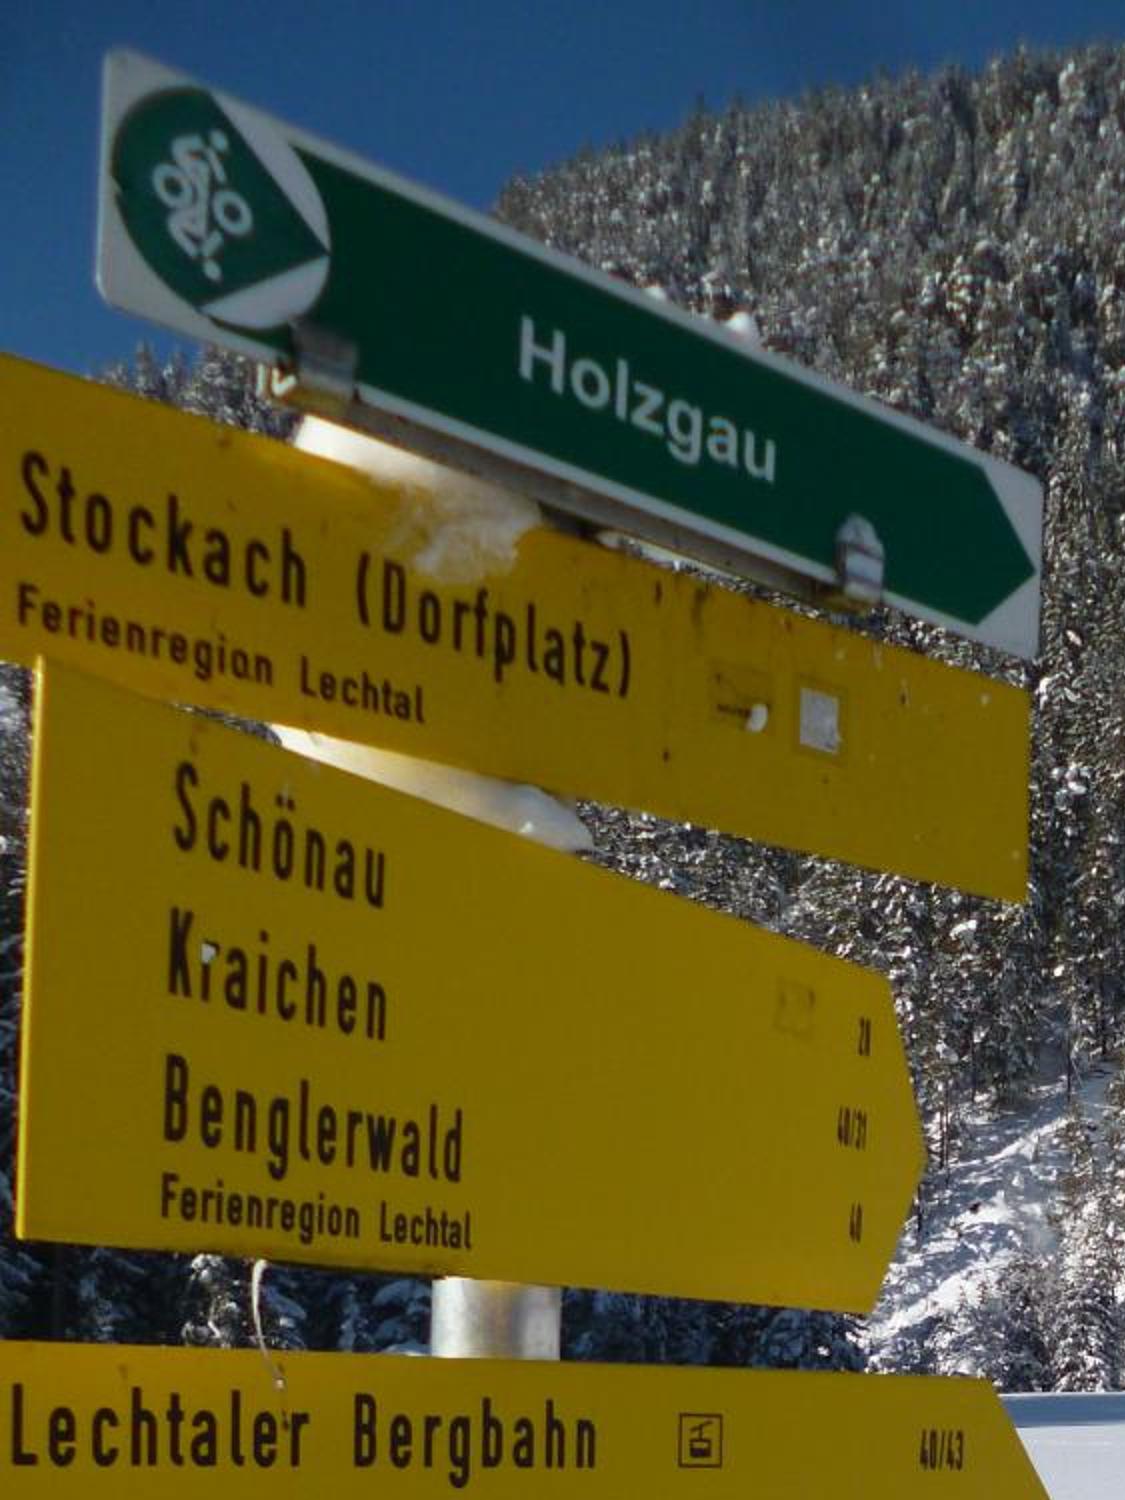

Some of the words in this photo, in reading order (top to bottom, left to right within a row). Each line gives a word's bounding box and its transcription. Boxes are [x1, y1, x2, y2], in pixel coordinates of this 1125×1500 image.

[518, 314, 777, 483] Holzgau
[20, 450, 308, 608] Stockach
[357, 550, 632, 697] (Dorfplatz)
[16, 582, 274, 686] Ferienregion
[300, 655, 426, 723] Lechtal
[173, 760, 387, 909] Schönau
[168, 906, 388, 1041] Kraichen
[163, 1053, 464, 1183] Benglerwald
[161, 1172, 360, 1245] Ferienregion
[380, 1201, 472, 1250] Lechtal
[11, 1383, 310, 1469] Lechtaler
[353, 1393, 597, 1488] Bergbahn
[919, 1428, 965, 1471] 40/43
